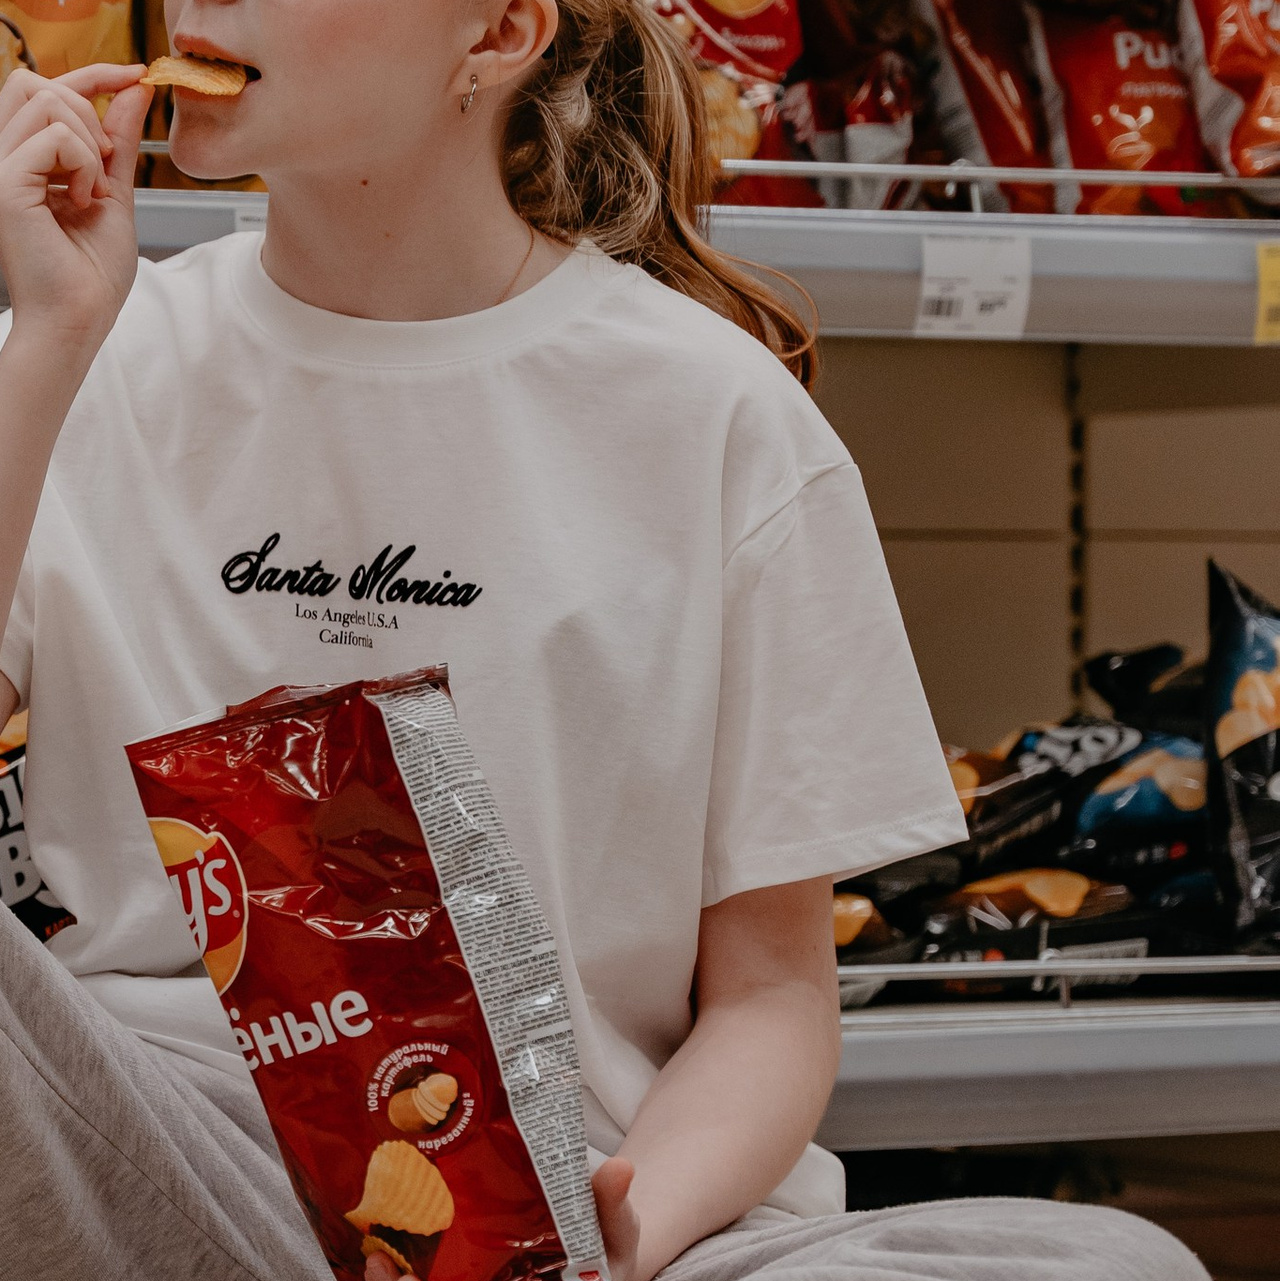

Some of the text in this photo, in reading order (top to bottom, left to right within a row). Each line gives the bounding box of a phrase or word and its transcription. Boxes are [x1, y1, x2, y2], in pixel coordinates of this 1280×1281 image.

[221, 532, 483, 608] Santa Monica
[295, 603, 399, 630] Los Angeles U.S.A
[319, 629, 374, 649] California
[177, 847, 235, 948] y's
[233, 988, 374, 1072] ёные
[367, 1042, 449, 1112] 100% натуральный
[381, 1053, 434, 1098] картофель
